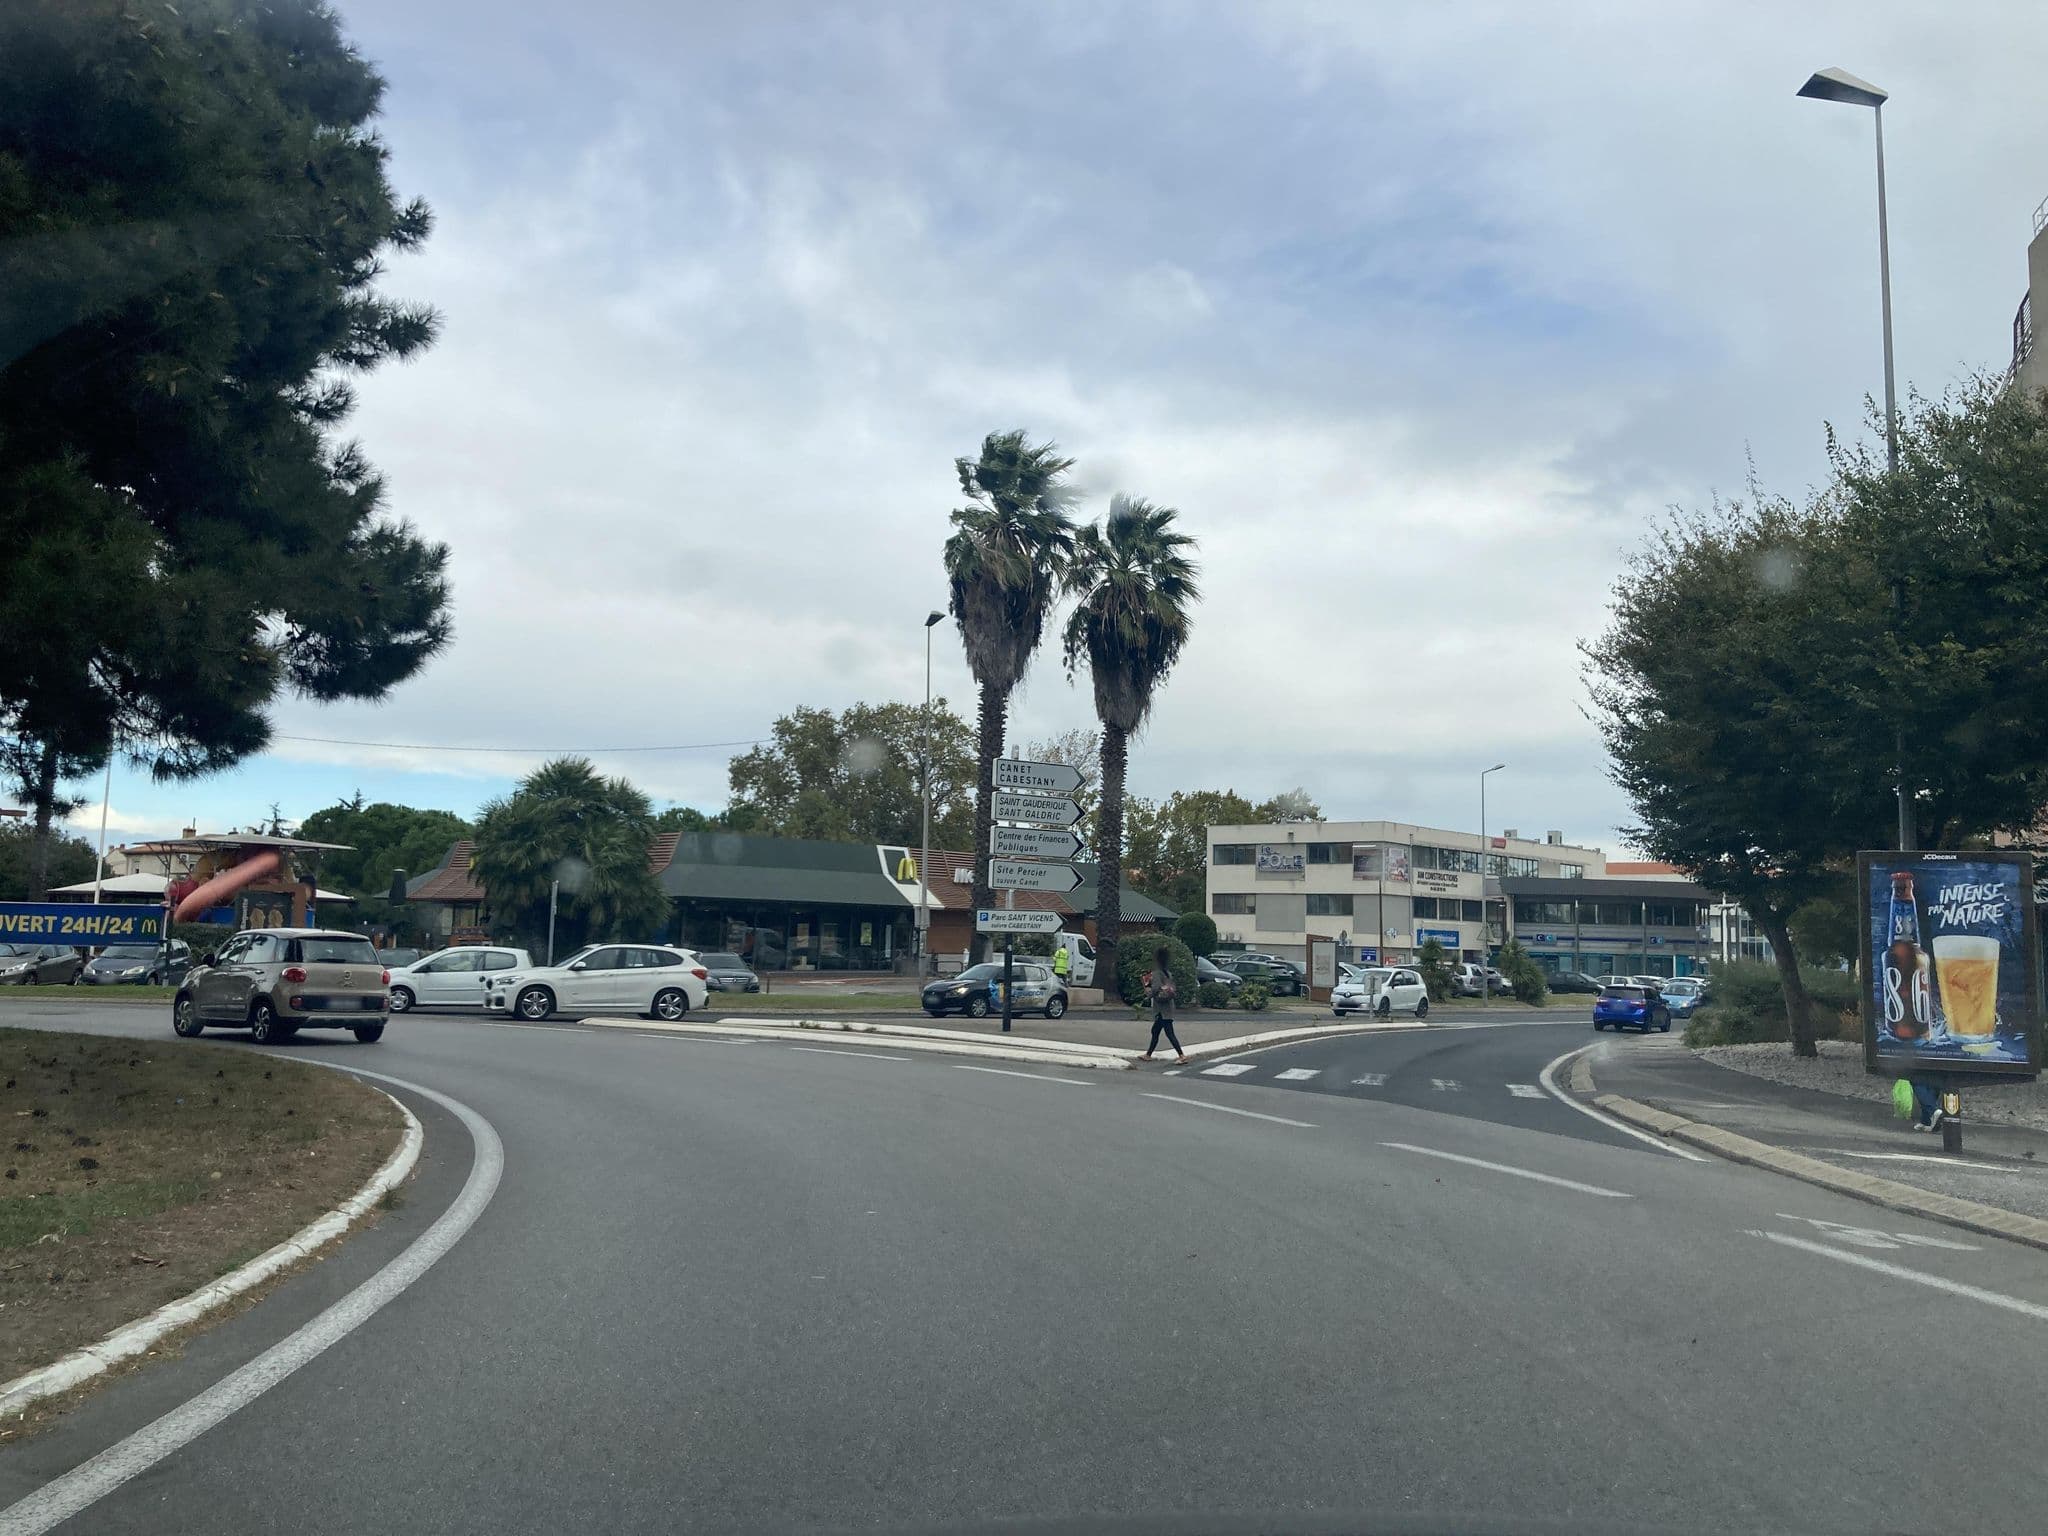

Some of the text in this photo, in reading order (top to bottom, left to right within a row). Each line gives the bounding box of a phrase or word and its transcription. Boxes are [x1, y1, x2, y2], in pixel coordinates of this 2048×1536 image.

[1000, 763, 1032, 774] CANET
[1000, 774, 1056, 786] CABESTANY
[1000, 797, 1067, 811] SAINT GAUDERIQUE
[999, 807, 1061, 820] SANT GALDRIC
[997, 831, 1069, 844] Centre des Finances
[997, 841, 1039, 853] Publiques
[996, 865, 1047, 877] Site Percier
[1020, 878, 1039, 886] Canet
[1928, 905, 1945, 916] PAR
[991, 913, 1006, 921] Parc
[1008, 913, 1027, 921] SANT
[1029, 914, 1054, 922] VICENS
